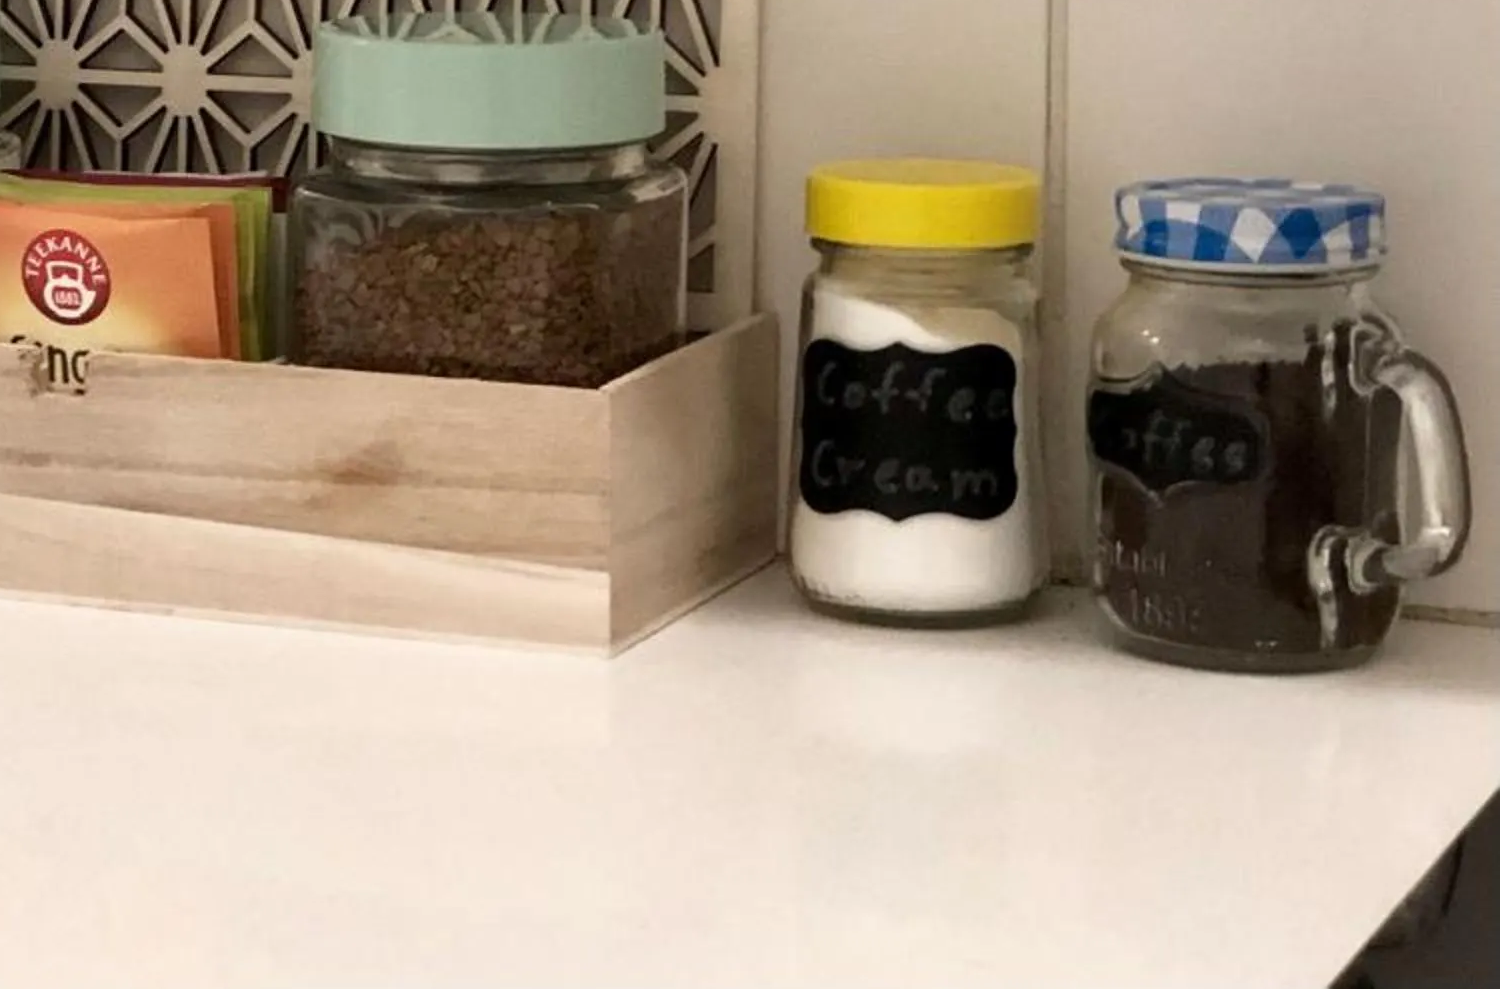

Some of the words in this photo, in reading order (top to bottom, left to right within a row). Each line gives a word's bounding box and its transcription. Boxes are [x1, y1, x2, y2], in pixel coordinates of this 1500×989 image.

[26, 237, 107, 285] TEEKANNE
[816, 359, 1010, 423] Coffee
[810, 438, 999, 501] Cream
